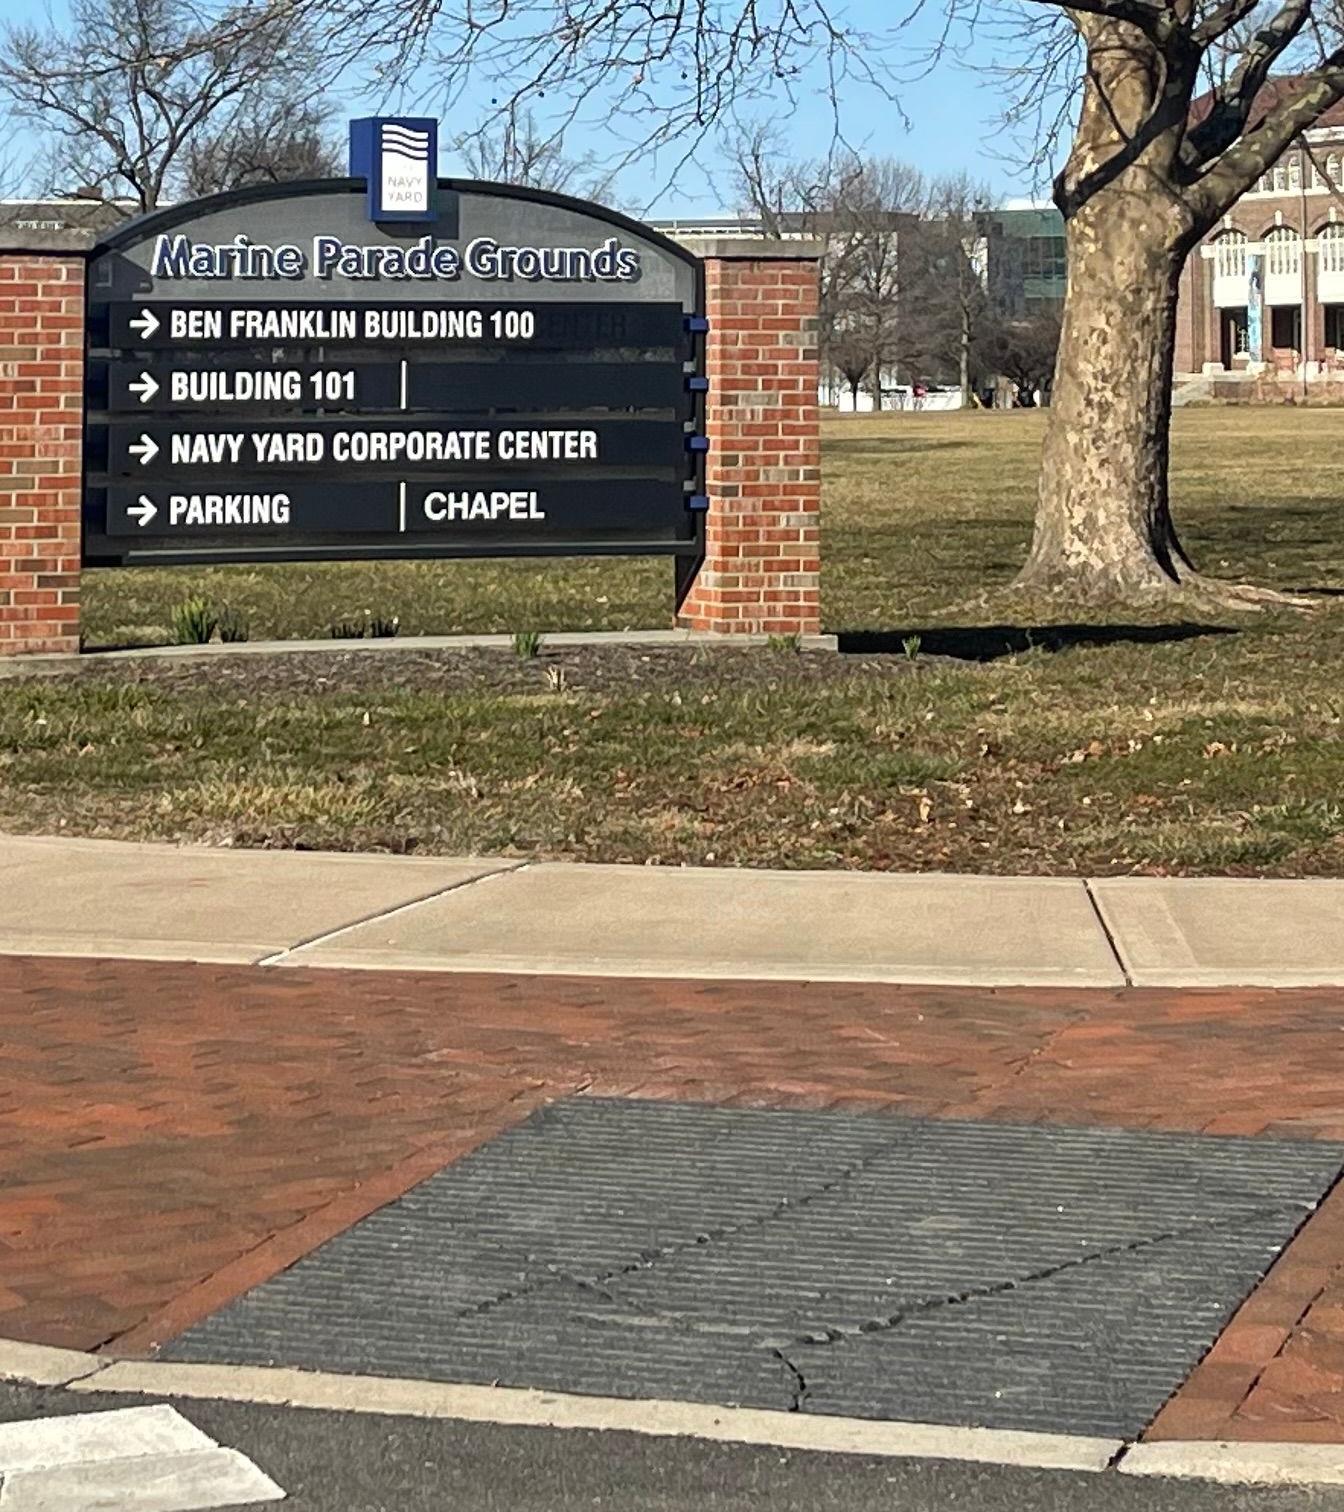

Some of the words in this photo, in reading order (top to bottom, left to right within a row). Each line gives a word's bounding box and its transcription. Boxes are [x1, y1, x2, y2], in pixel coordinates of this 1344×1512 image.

[387, 175, 422, 187] NAVY
[388, 191, 423, 203] YARD
[151, 234, 305, 278] Marine
[312, 235, 459, 278] Parade
[464, 237, 639, 280] Grounds
[170, 310, 222, 339] BEN
[230, 309, 356, 339] FRANKLIN
[364, 310, 483, 339] BUILDING
[489, 310, 535, 339] 100
[171, 370, 302, 402] BUILDING
[309, 370, 355, 401] 101
[171, 433, 245, 464] NAVY
[251, 432, 324, 463] YARD
[332, 430, 491, 462] CORPORATE
[497, 430, 598, 460] CENTER
[169, 493, 291, 526] PARKING
[424, 491, 545, 521] CHAPEL
